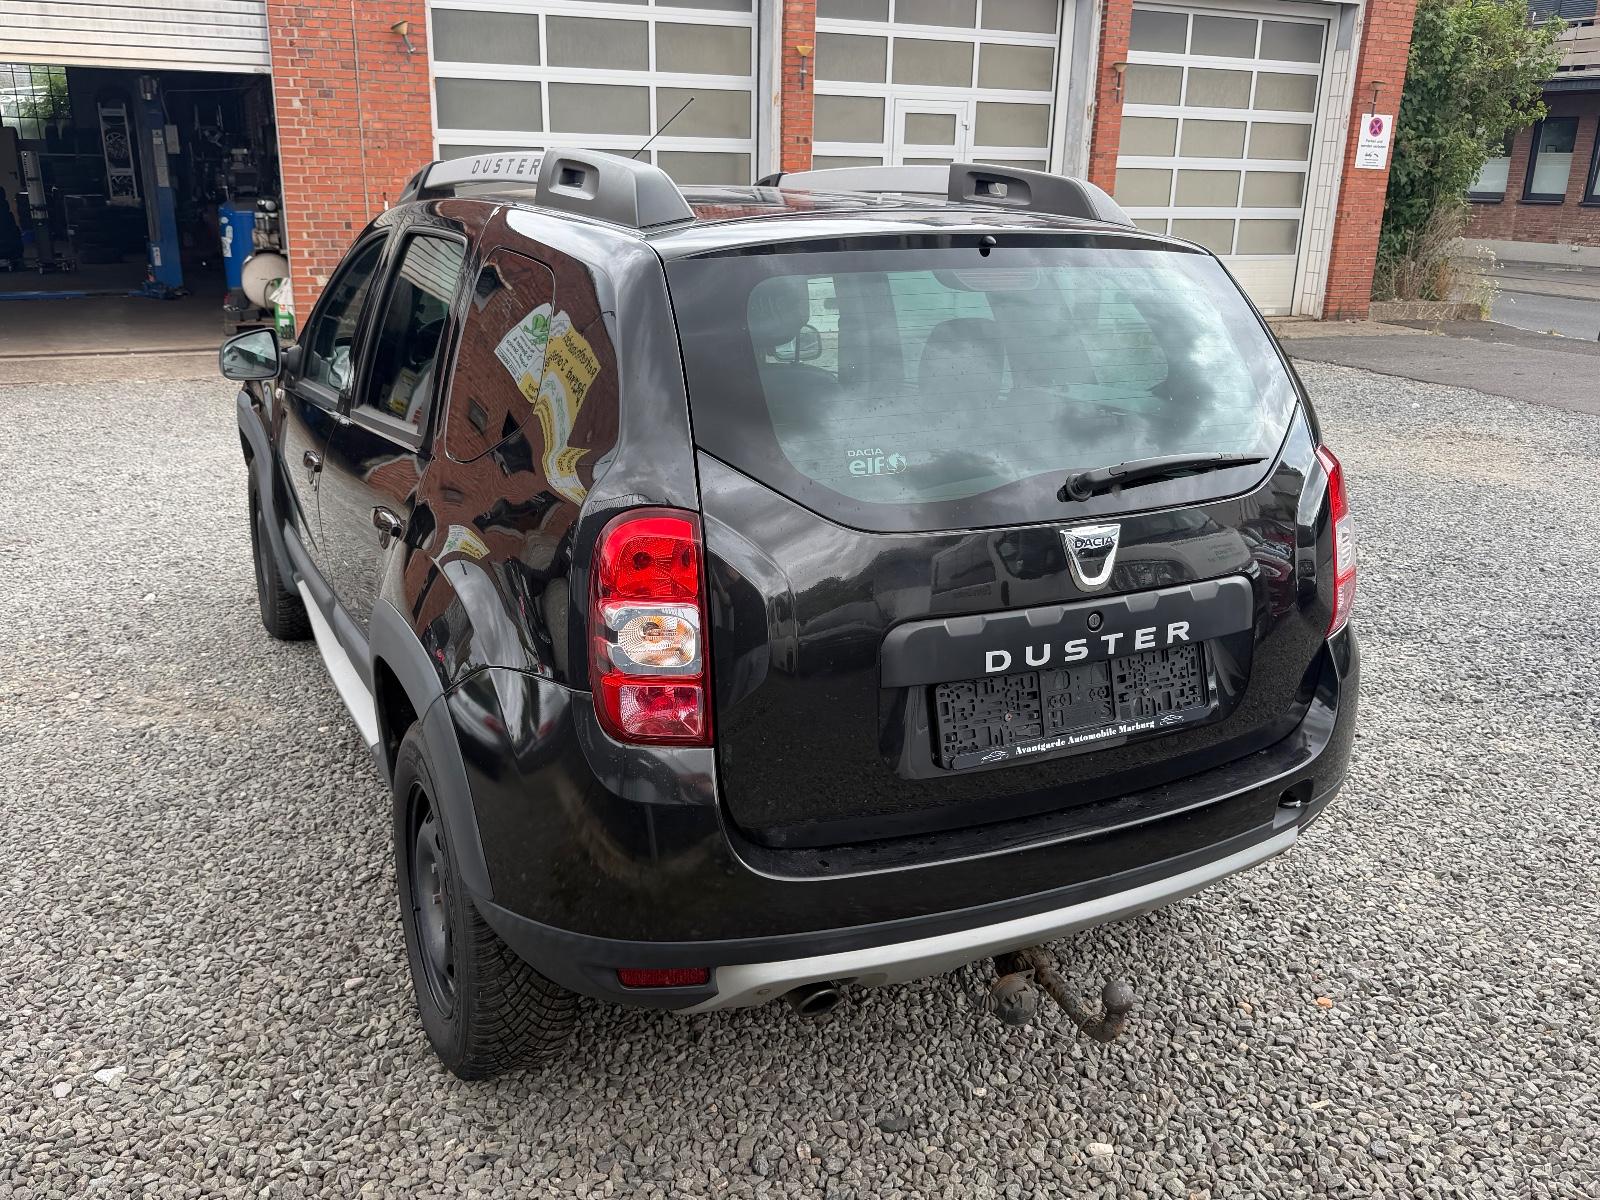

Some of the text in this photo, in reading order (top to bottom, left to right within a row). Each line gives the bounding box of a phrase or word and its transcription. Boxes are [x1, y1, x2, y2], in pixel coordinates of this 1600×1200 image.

[471, 158, 541, 175] DUSTER
[847, 447, 884, 457] DACIA
[848, 456, 885, 475] elf
[1073, 535, 1115, 549] DACIA
[984, 620, 1191, 674] DUSTER
[1015, 720, 1155, 756] Avantgarde Automobile Marburg
